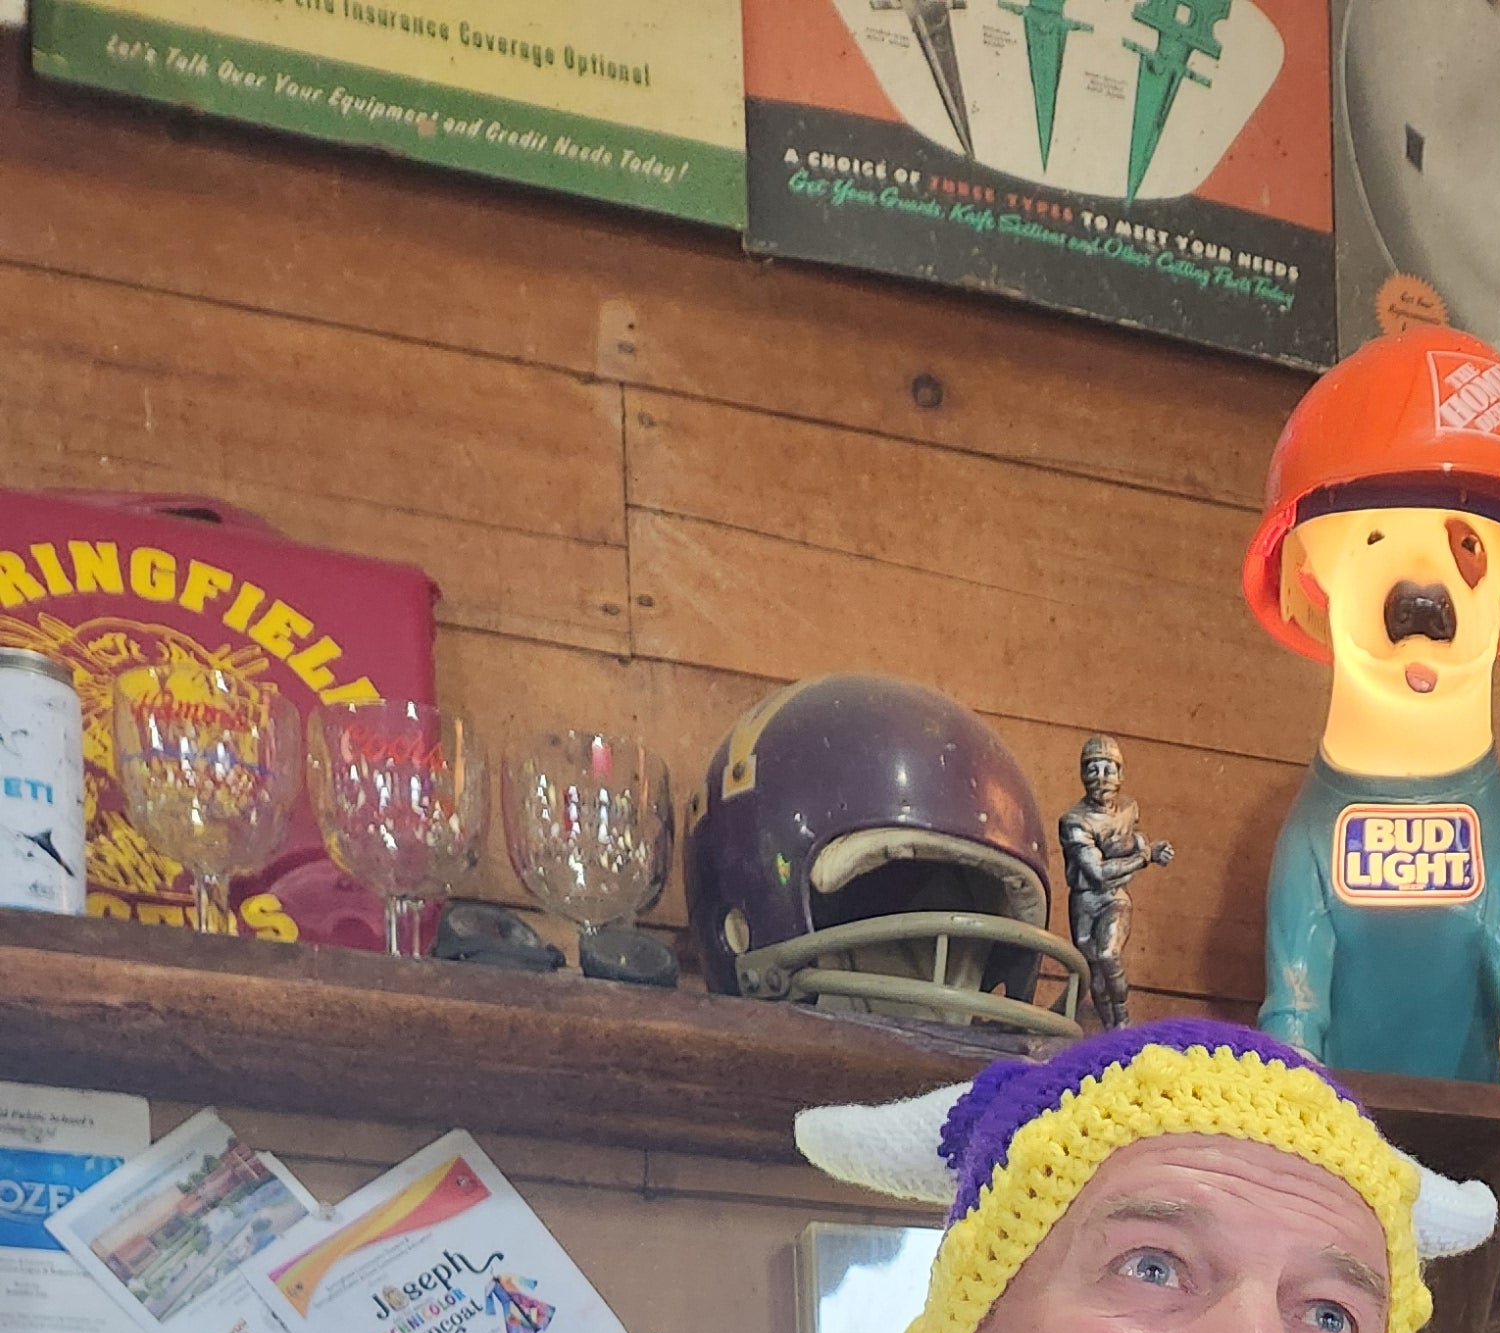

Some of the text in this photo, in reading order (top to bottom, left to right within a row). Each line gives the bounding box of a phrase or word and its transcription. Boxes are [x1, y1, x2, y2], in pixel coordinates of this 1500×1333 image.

[343, 0, 650, 87] Insurance Coverage Optional
[164, 47, 209, 77] Talk
[218, 58, 267, 89] Over
[274, 72, 324, 102] Your
[327, 85, 439, 126] Equipment
[442, 115, 485, 137] and
[486, 121, 549, 152] Credit
[552, 136, 613, 167] Needs
[620, 149, 689, 184] Today!
[784, 147, 800, 165] A
[807, 150, 888, 179] CHOICE
[894, 166, 921, 186] OF
[1081, 210, 1109, 231] TO
[1115, 219, 1169, 246] MEET
[1175, 234, 1232, 263] YOUR
[1238, 251, 1299, 282] NEEDS
[1347, 851, 1470, 886] LIGHT
[1364, 818, 1455, 853] BUD
[372, 1249, 504, 1320] Joseph
